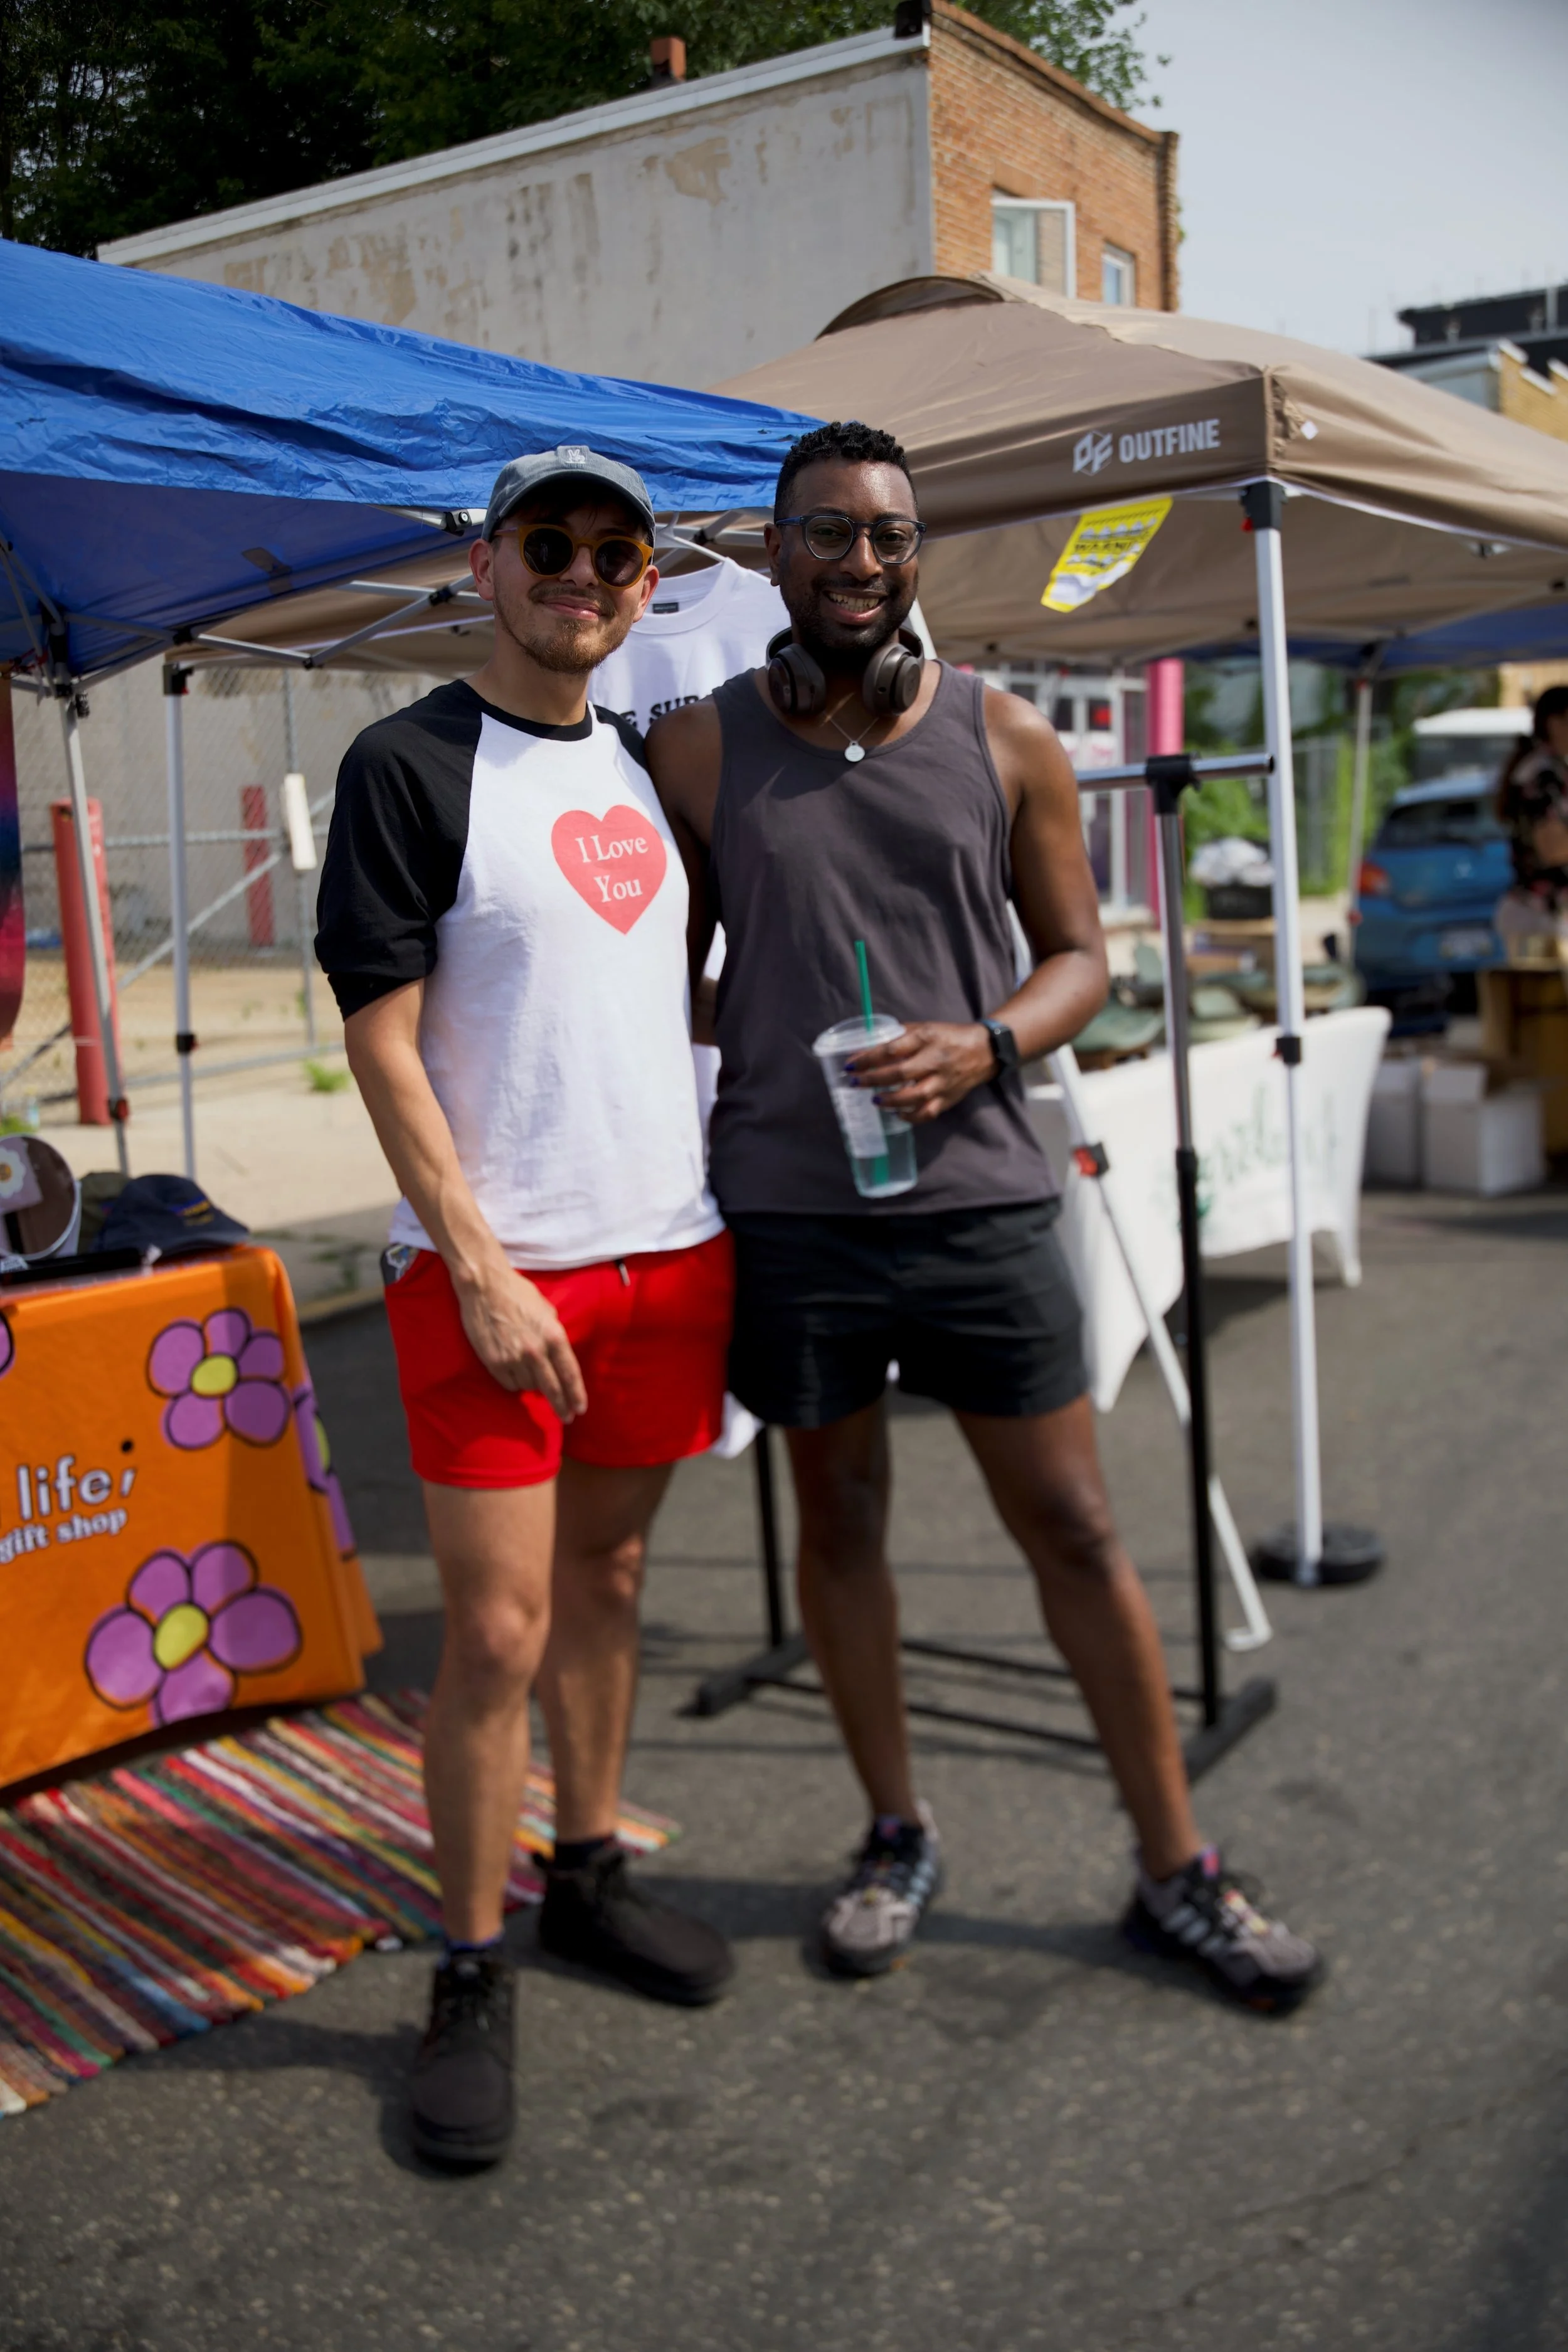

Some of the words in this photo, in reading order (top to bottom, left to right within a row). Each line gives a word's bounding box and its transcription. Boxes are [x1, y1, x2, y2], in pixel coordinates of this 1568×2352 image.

[1119, 419, 1221, 463] OUTFINE
[575, 837, 591, 863] I
[590, 835, 649, 861] Love
[593, 875, 643, 903] You
[57, 1508, 128, 1543] shop
